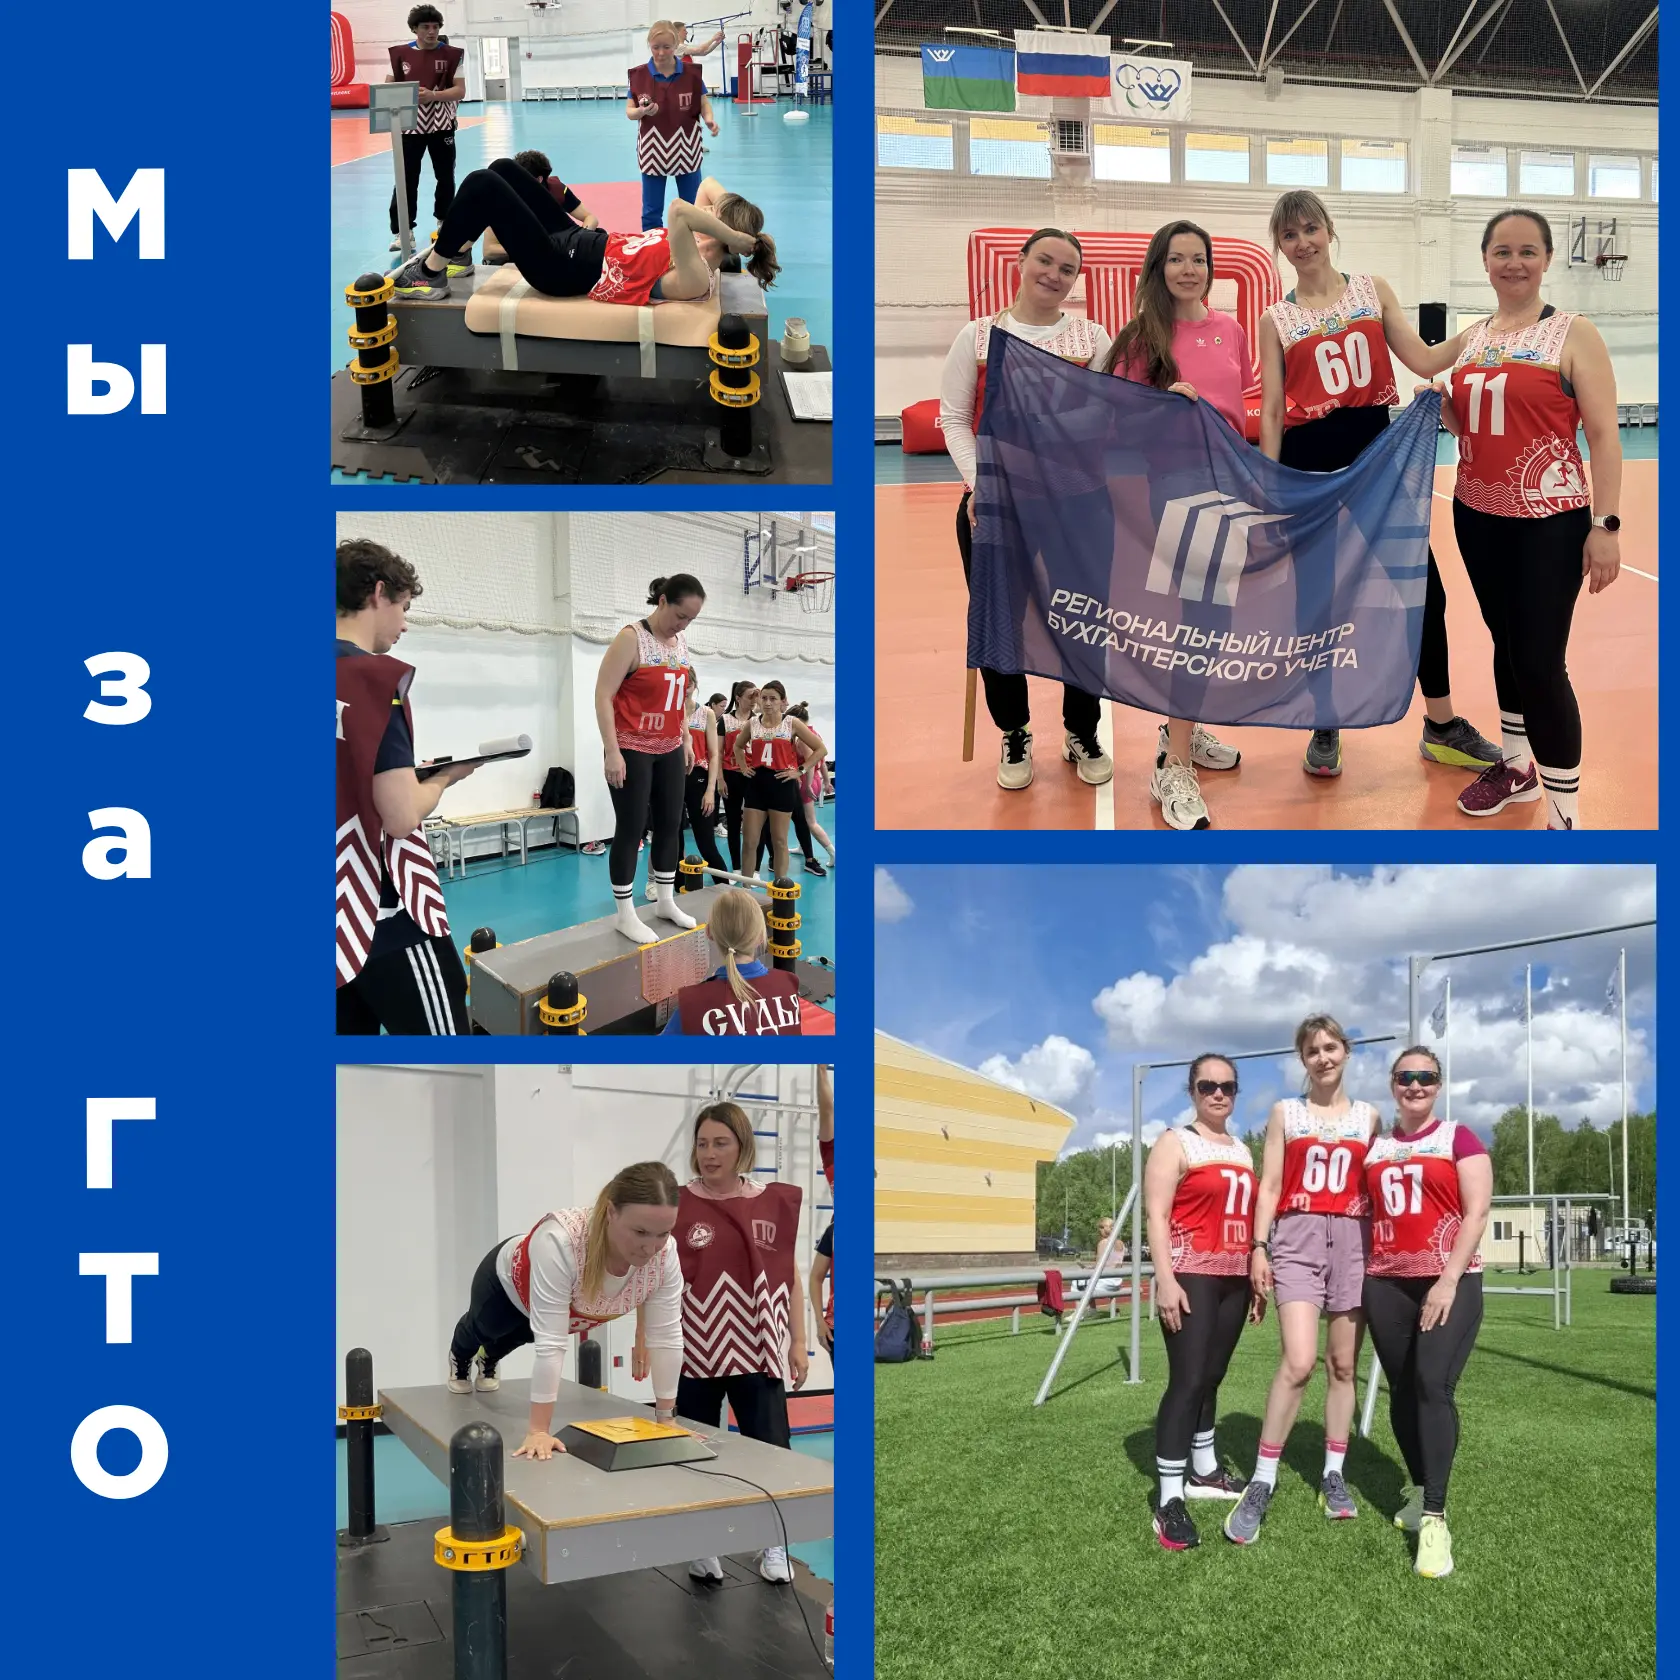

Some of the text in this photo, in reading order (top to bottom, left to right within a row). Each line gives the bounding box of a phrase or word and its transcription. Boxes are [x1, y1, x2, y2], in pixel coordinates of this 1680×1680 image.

[1314, 331, 1372, 396] 60
[1557, 496, 1584, 509] ГТО
[1050, 588, 1356, 658] РЕГИОНАЛЬНЫЙ ЦЕНТР
[1047, 610, 1359, 681] БУХГАЛТЕРСКОГО УЧЕТА
[664, 672, 686, 712] 71
[638, 711, 665, 731] ГТО
[761, 742, 774, 767] 4
[1302, 1144, 1352, 1194] 60
[1220, 1169, 1252, 1216] 71
[1381, 1164, 1424, 1217] 67
[751, 1219, 777, 1244] ГТО
[1223, 1219, 1248, 1243] ГТО
[463, 1548, 511, 1565] ГТО
